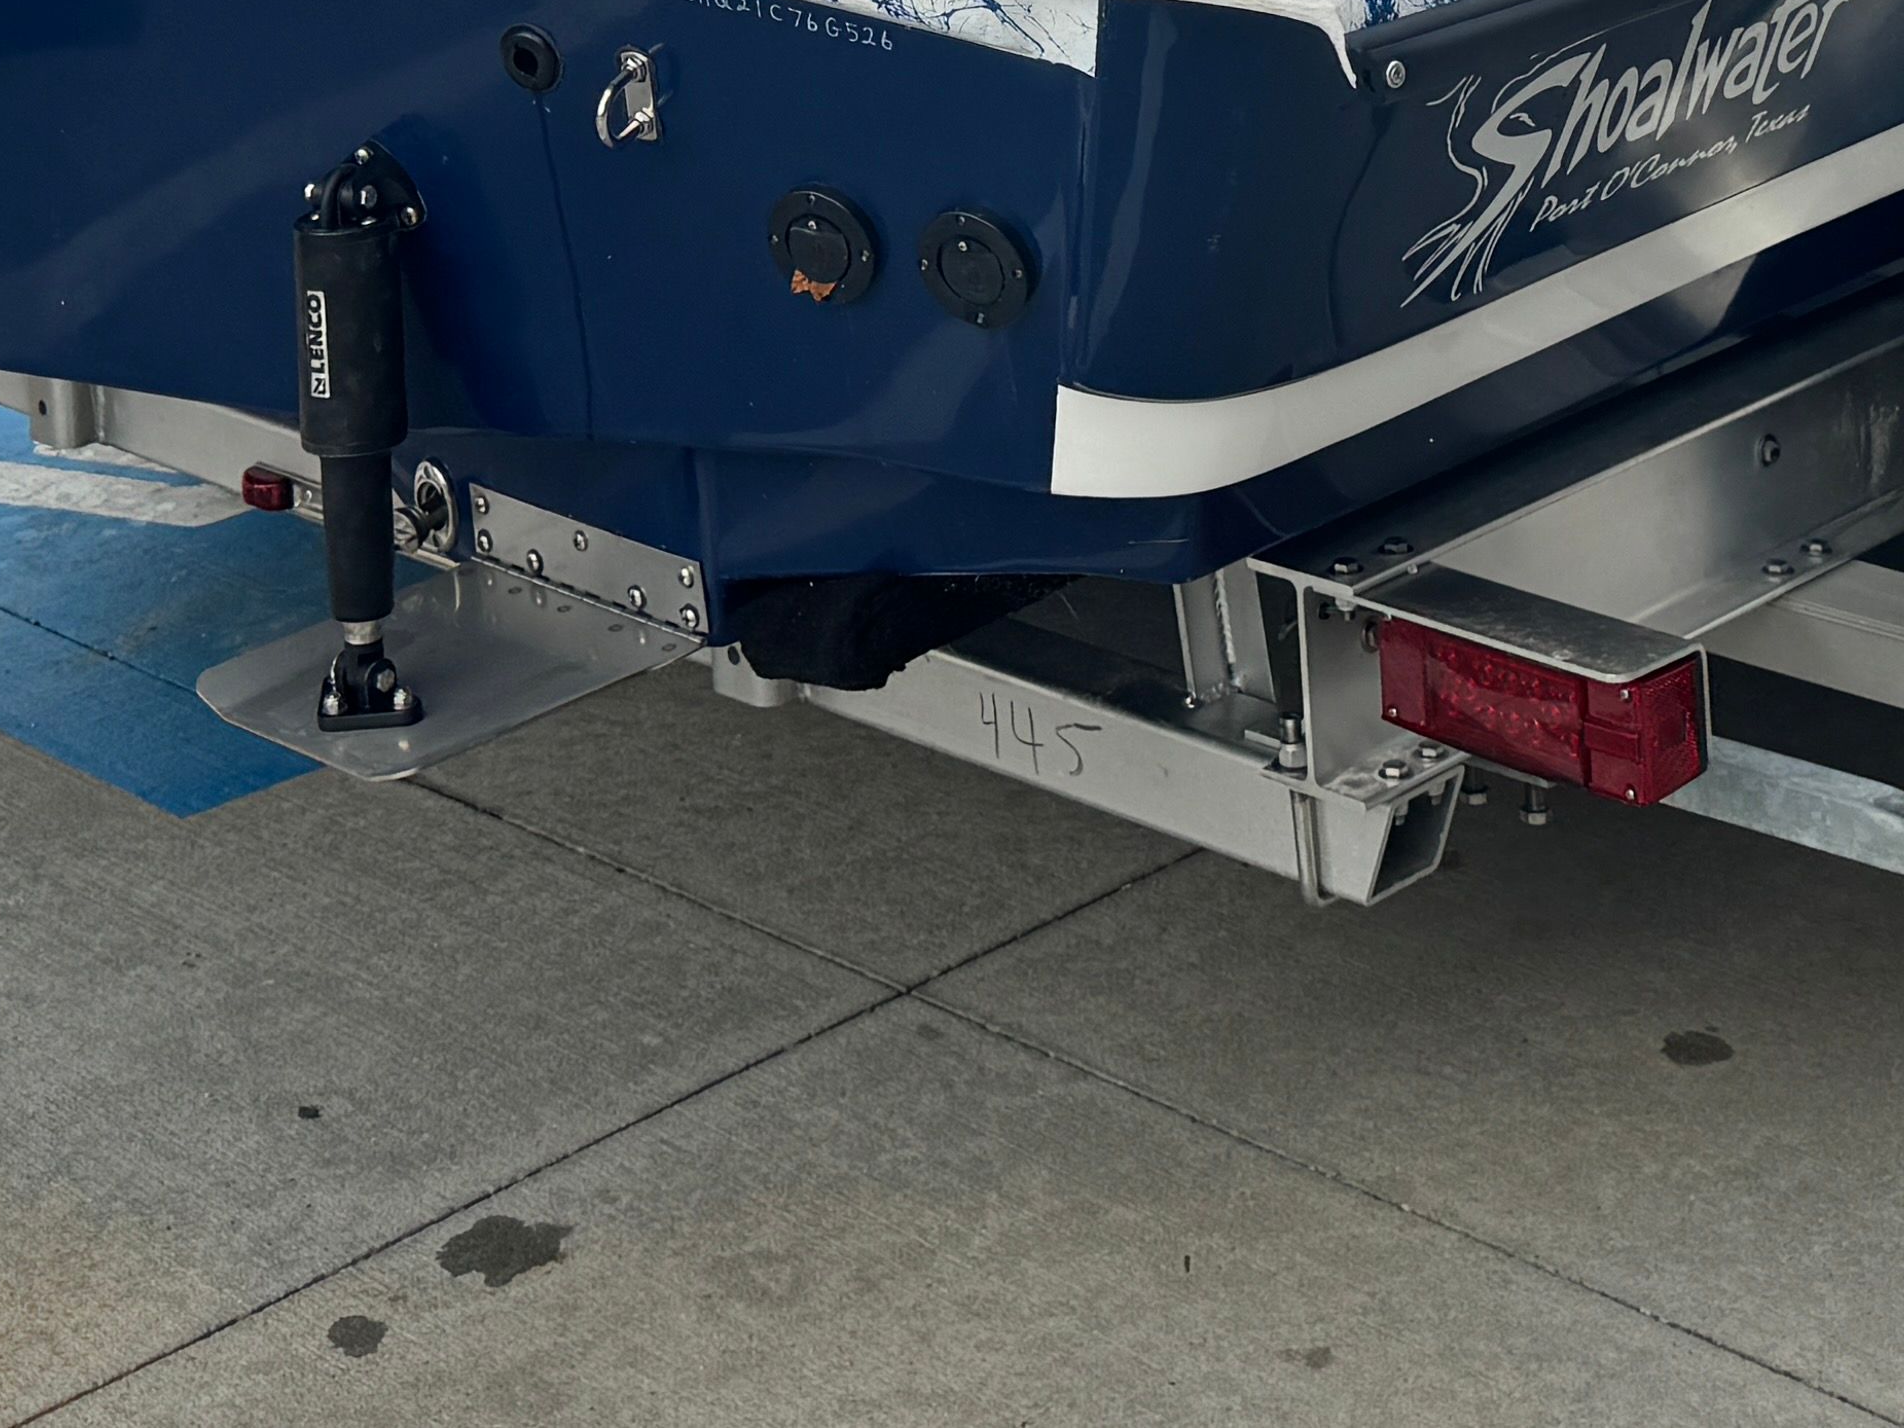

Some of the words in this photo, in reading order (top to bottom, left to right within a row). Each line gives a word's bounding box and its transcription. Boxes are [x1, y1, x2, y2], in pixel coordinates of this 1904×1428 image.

[1529, 184, 1600, 232] Port
[1745, 104, 1811, 143] Texas
[306, 294, 326, 372] LENCO
[979, 691, 1103, 776] 445
